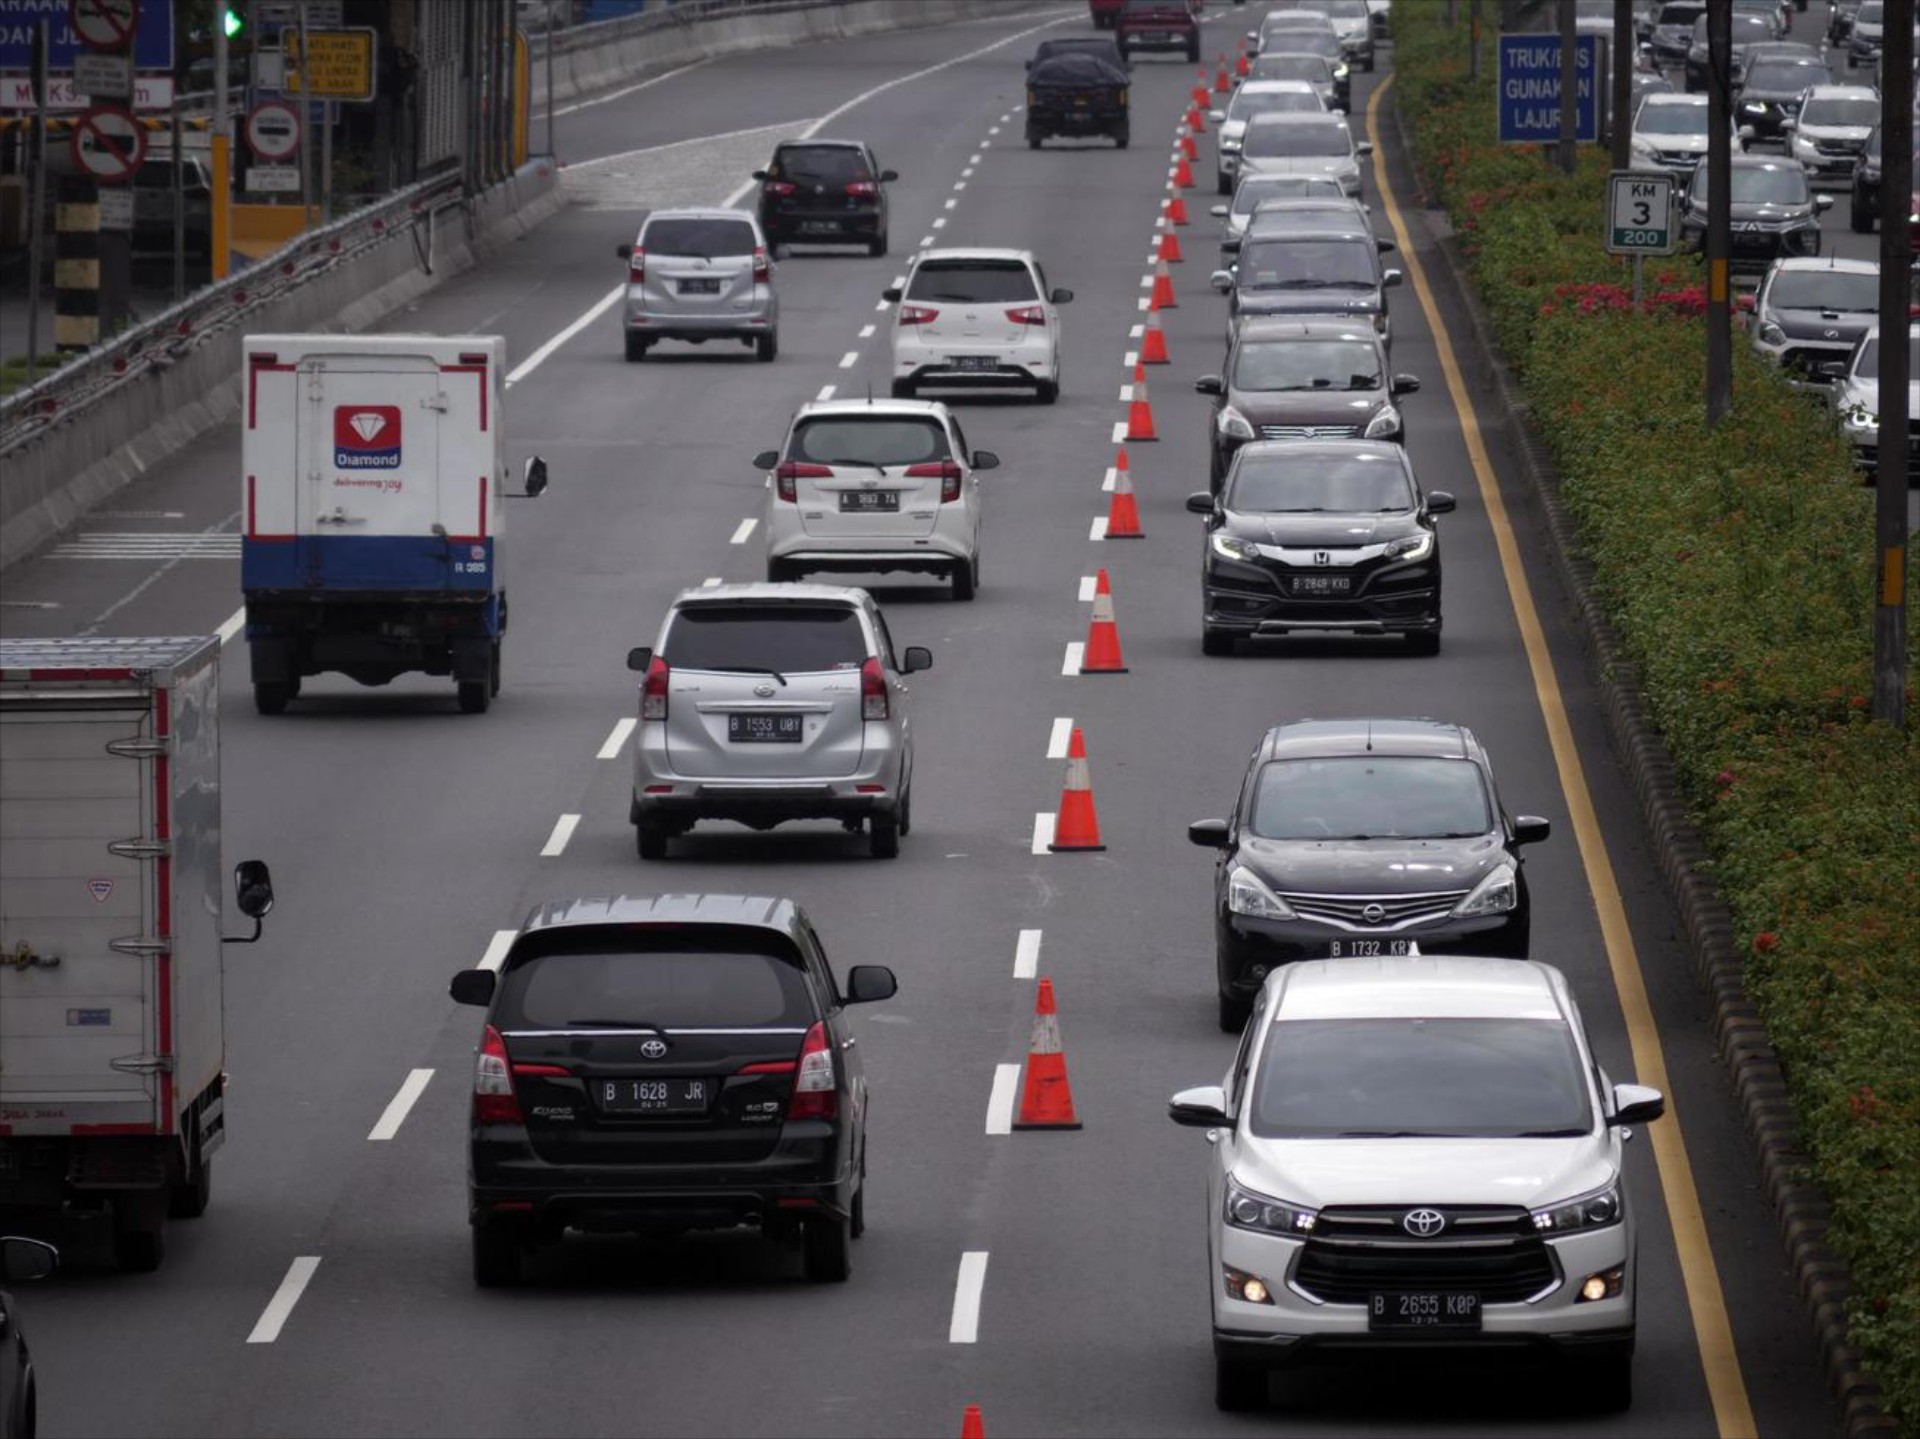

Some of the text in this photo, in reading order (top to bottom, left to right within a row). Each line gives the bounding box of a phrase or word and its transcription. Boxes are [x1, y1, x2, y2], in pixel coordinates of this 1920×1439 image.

[1507, 47, 1589, 69] TRUK/S
[1506, 79, 1589, 99] GUNAKN
[1631, 184, 1656, 198] KM
[1632, 201, 1651, 225] 3
[1623, 231, 1658, 244] 200
[337, 453, 399, 466] Diamond
[731, 717, 738, 731] B
[1333, 940, 1341, 957] B
[1351, 940, 1381, 957] 1732
[606, 1082, 703, 1100] B 1628 JR
[1374, 1295, 1385, 1315] B
[1399, 1295, 1440, 1315] 2655
